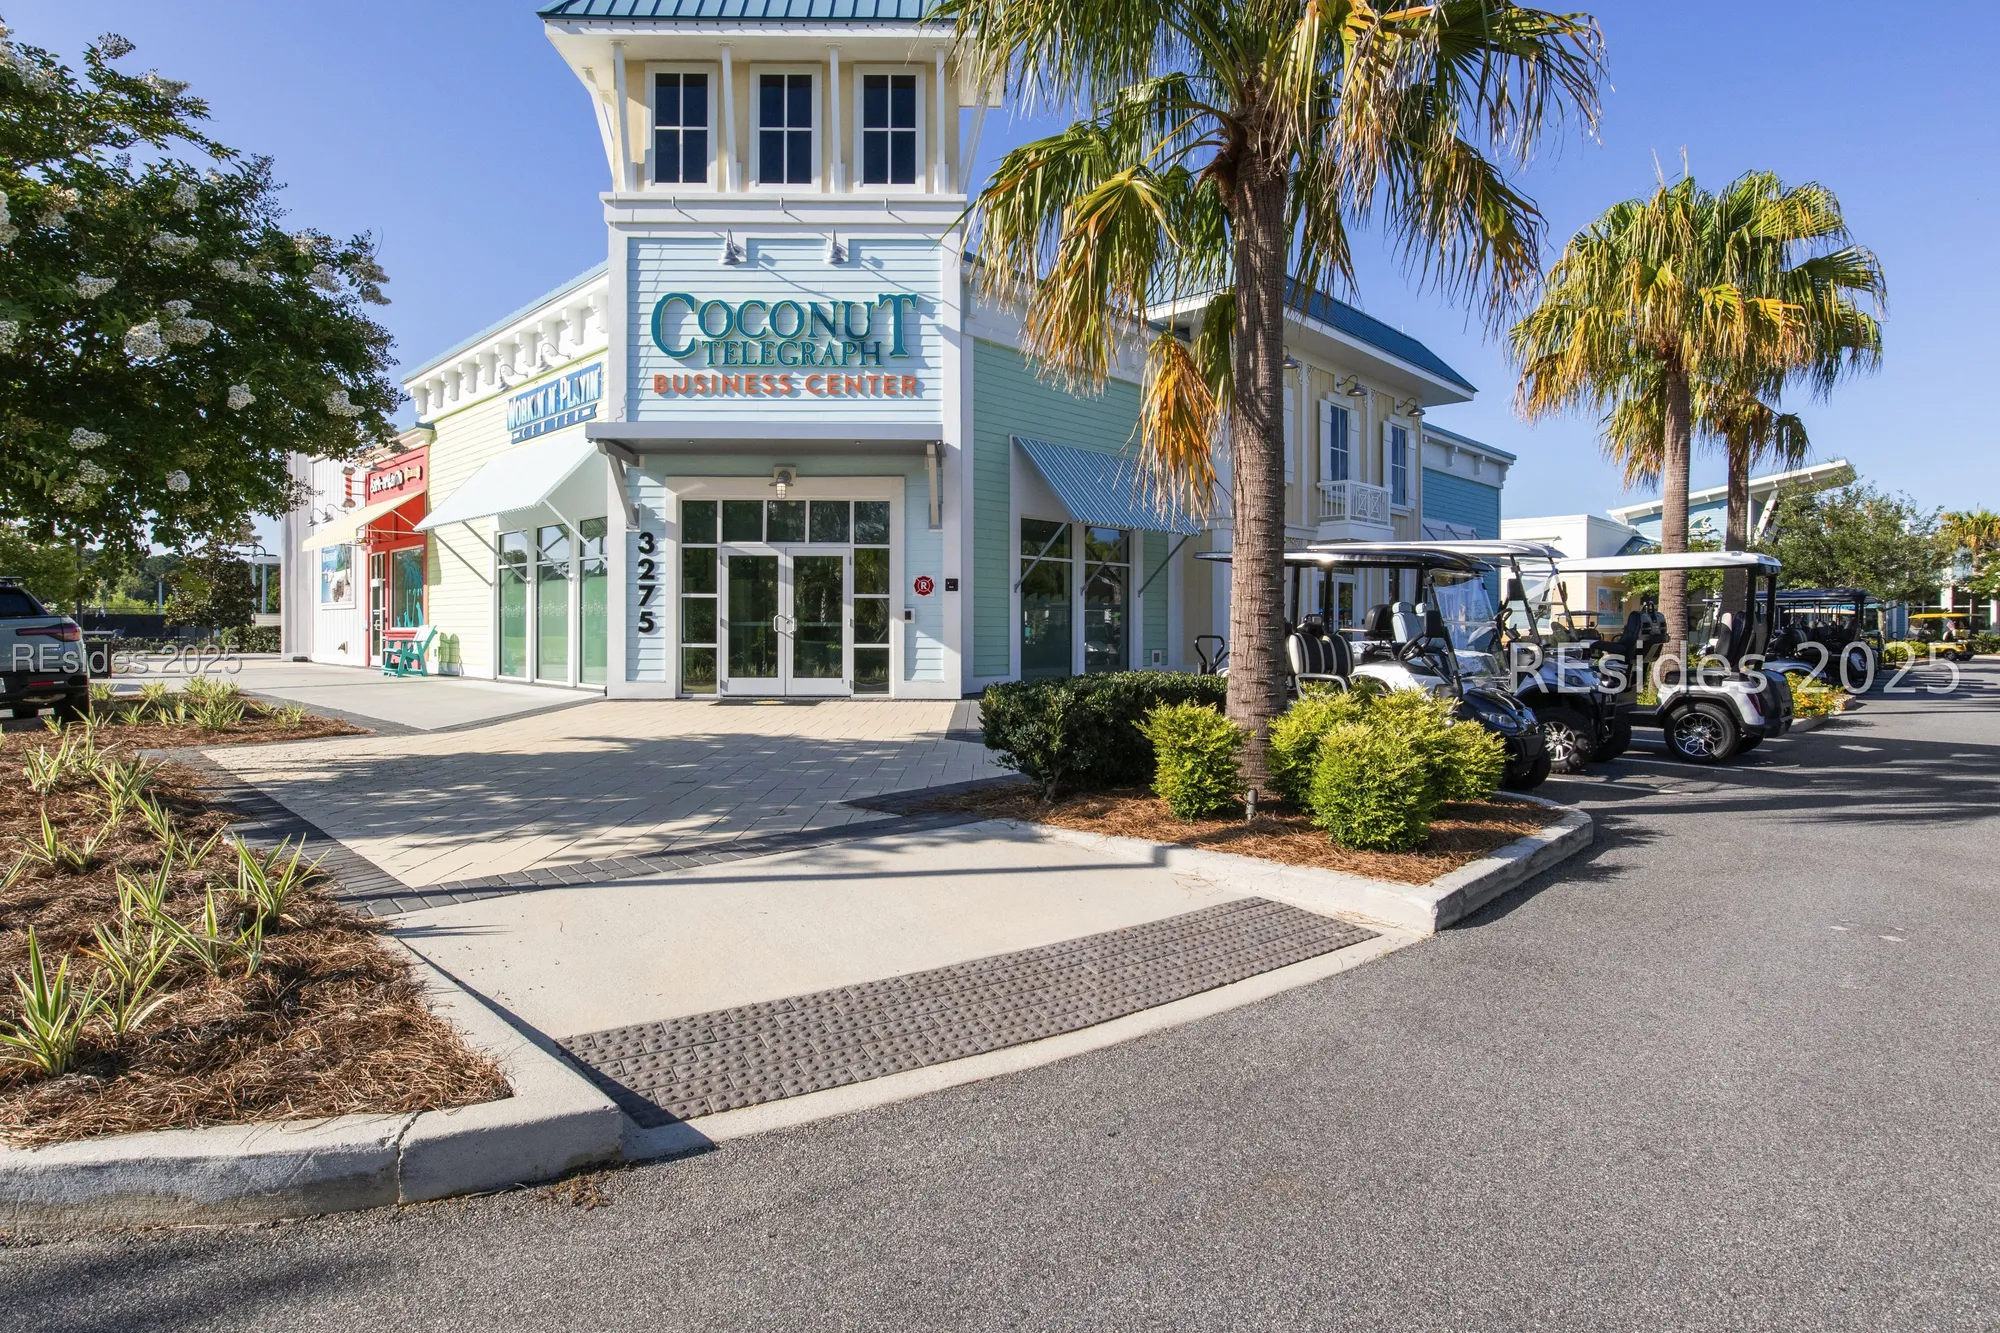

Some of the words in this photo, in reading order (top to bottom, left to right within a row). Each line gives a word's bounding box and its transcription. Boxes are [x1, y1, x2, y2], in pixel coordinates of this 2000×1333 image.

[651, 292, 918, 359] COCONUT
[701, 340, 883, 367] TELEGRAPH
[653, 374, 792, 394] BUSINESS
[805, 375, 917, 395] CENTER
[522, 410, 579, 438] CENTER
